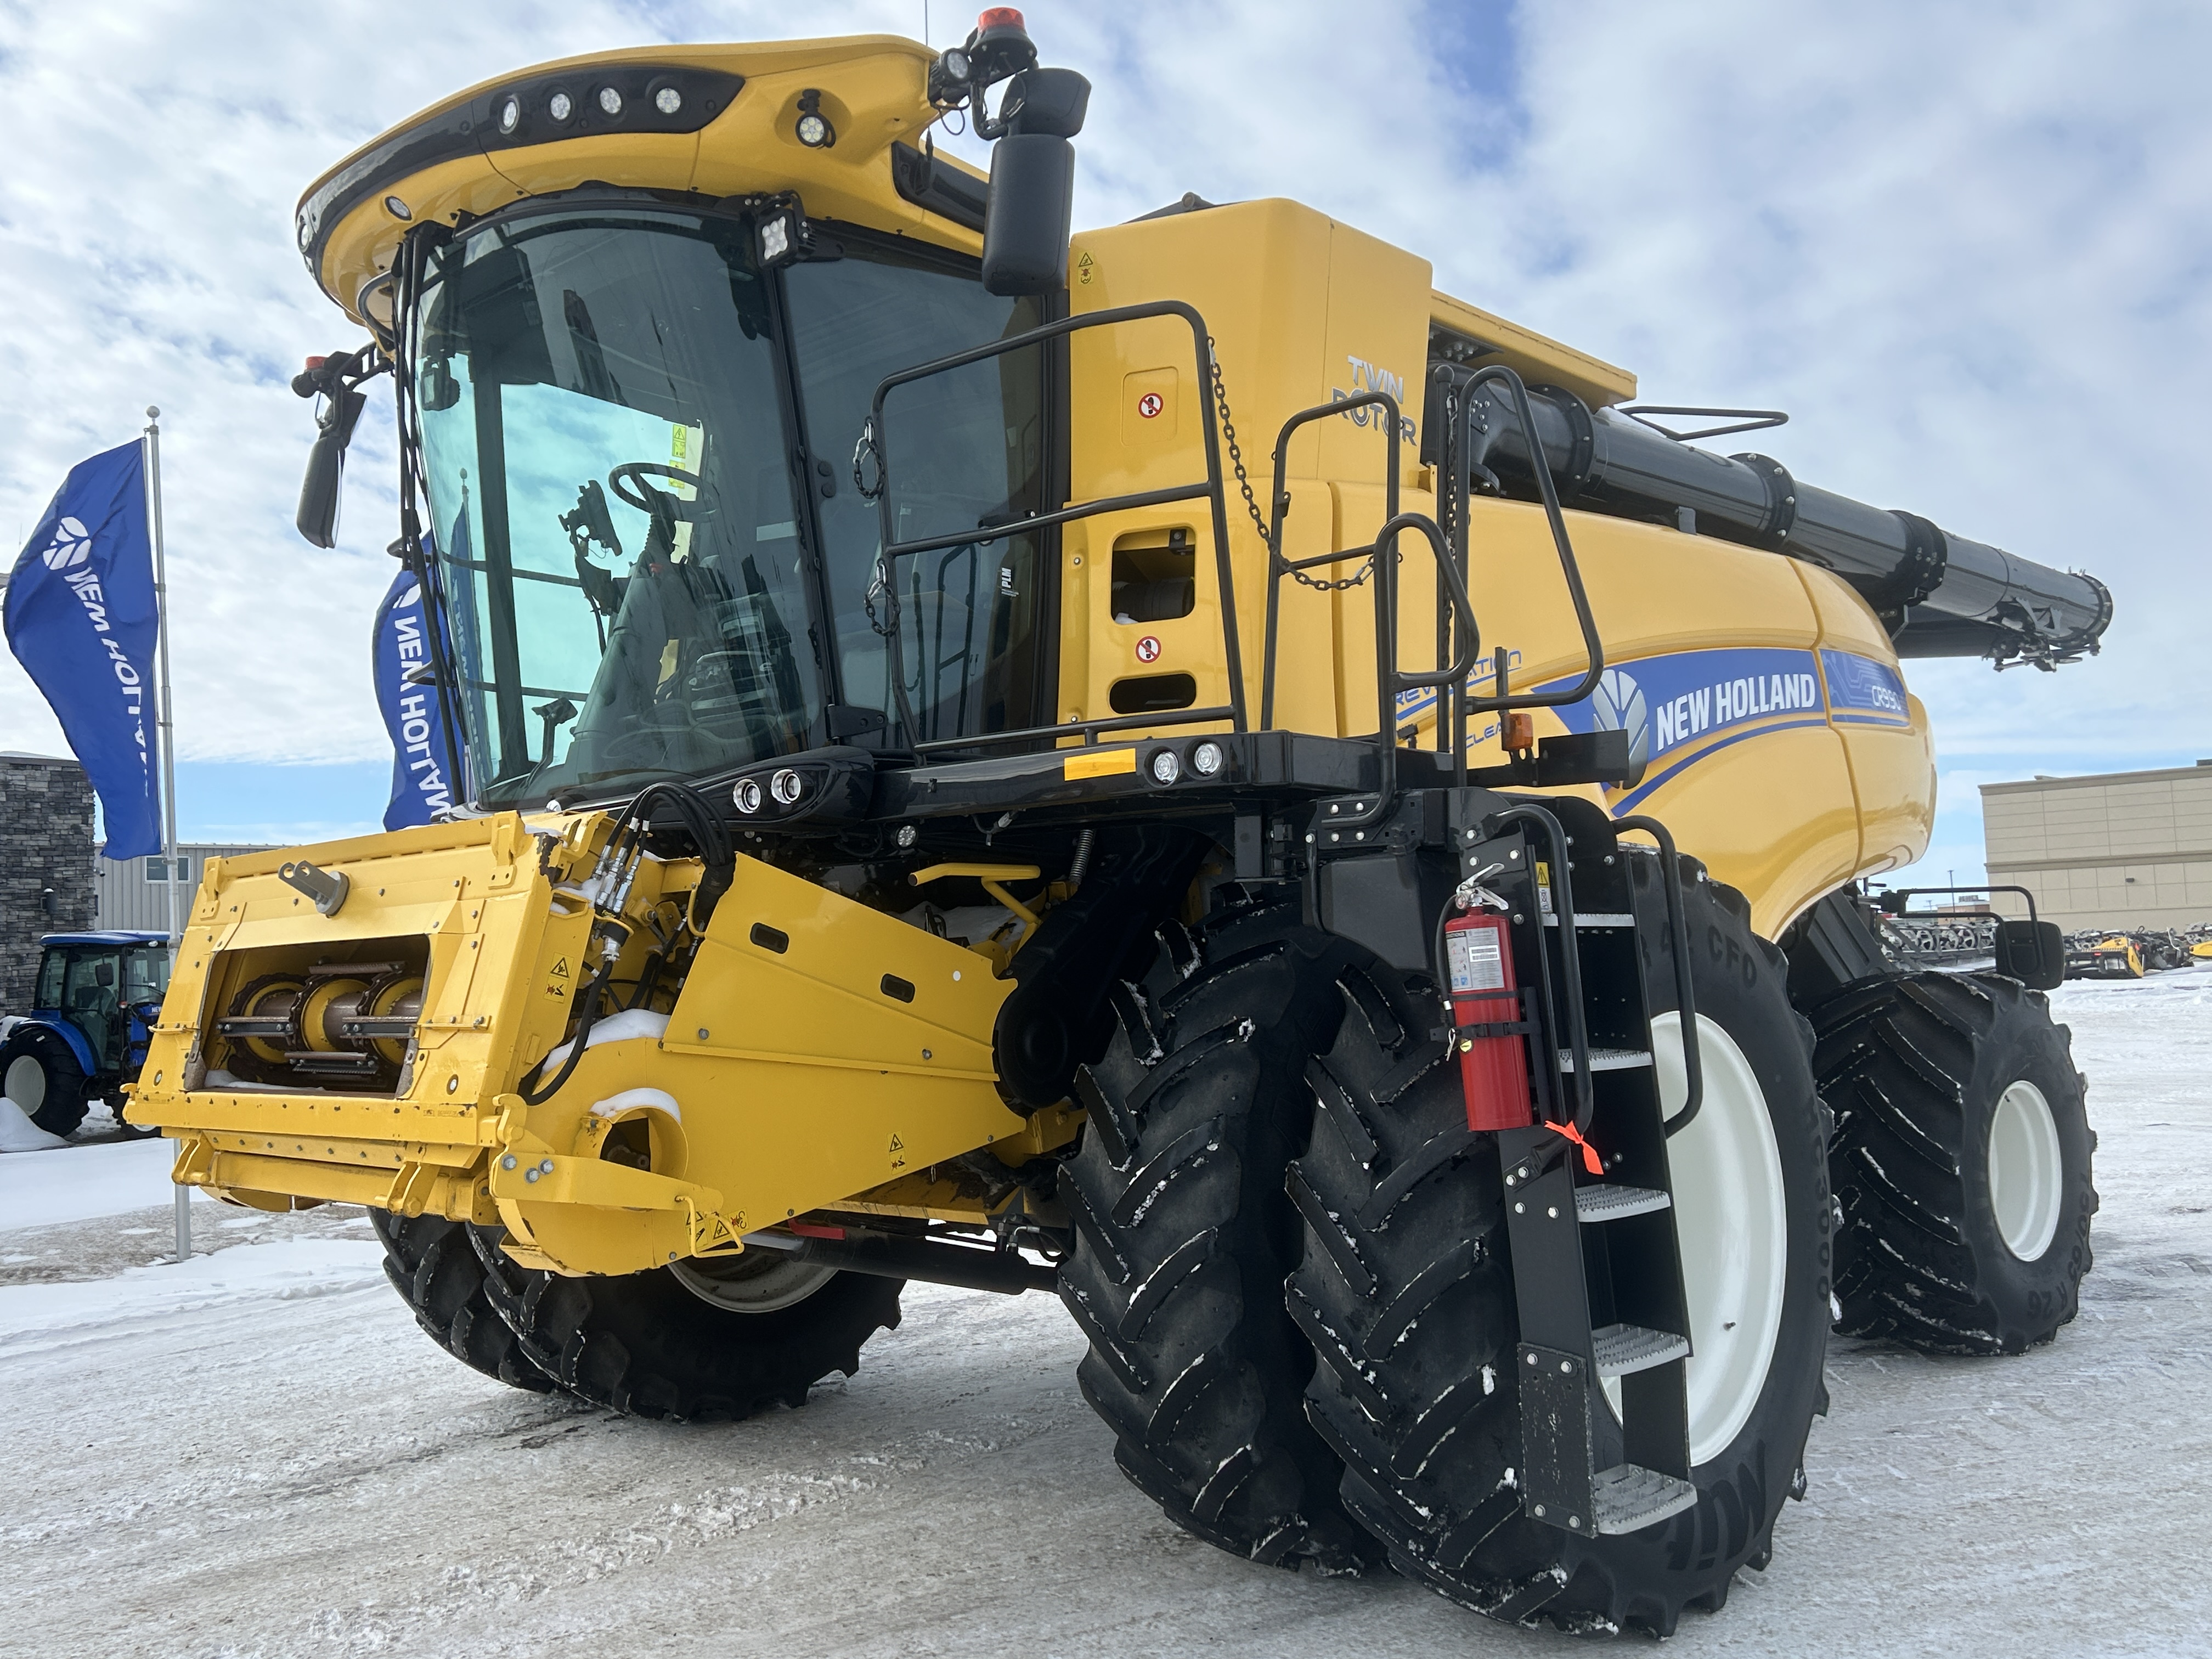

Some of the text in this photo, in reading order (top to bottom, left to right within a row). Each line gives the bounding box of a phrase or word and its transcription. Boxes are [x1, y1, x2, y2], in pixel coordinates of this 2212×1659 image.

[1347, 355, 1403, 404] TWIN
[1002, 567, 1011, 589] PLM
[1656, 674, 1815, 751] NEW HOLLAND
